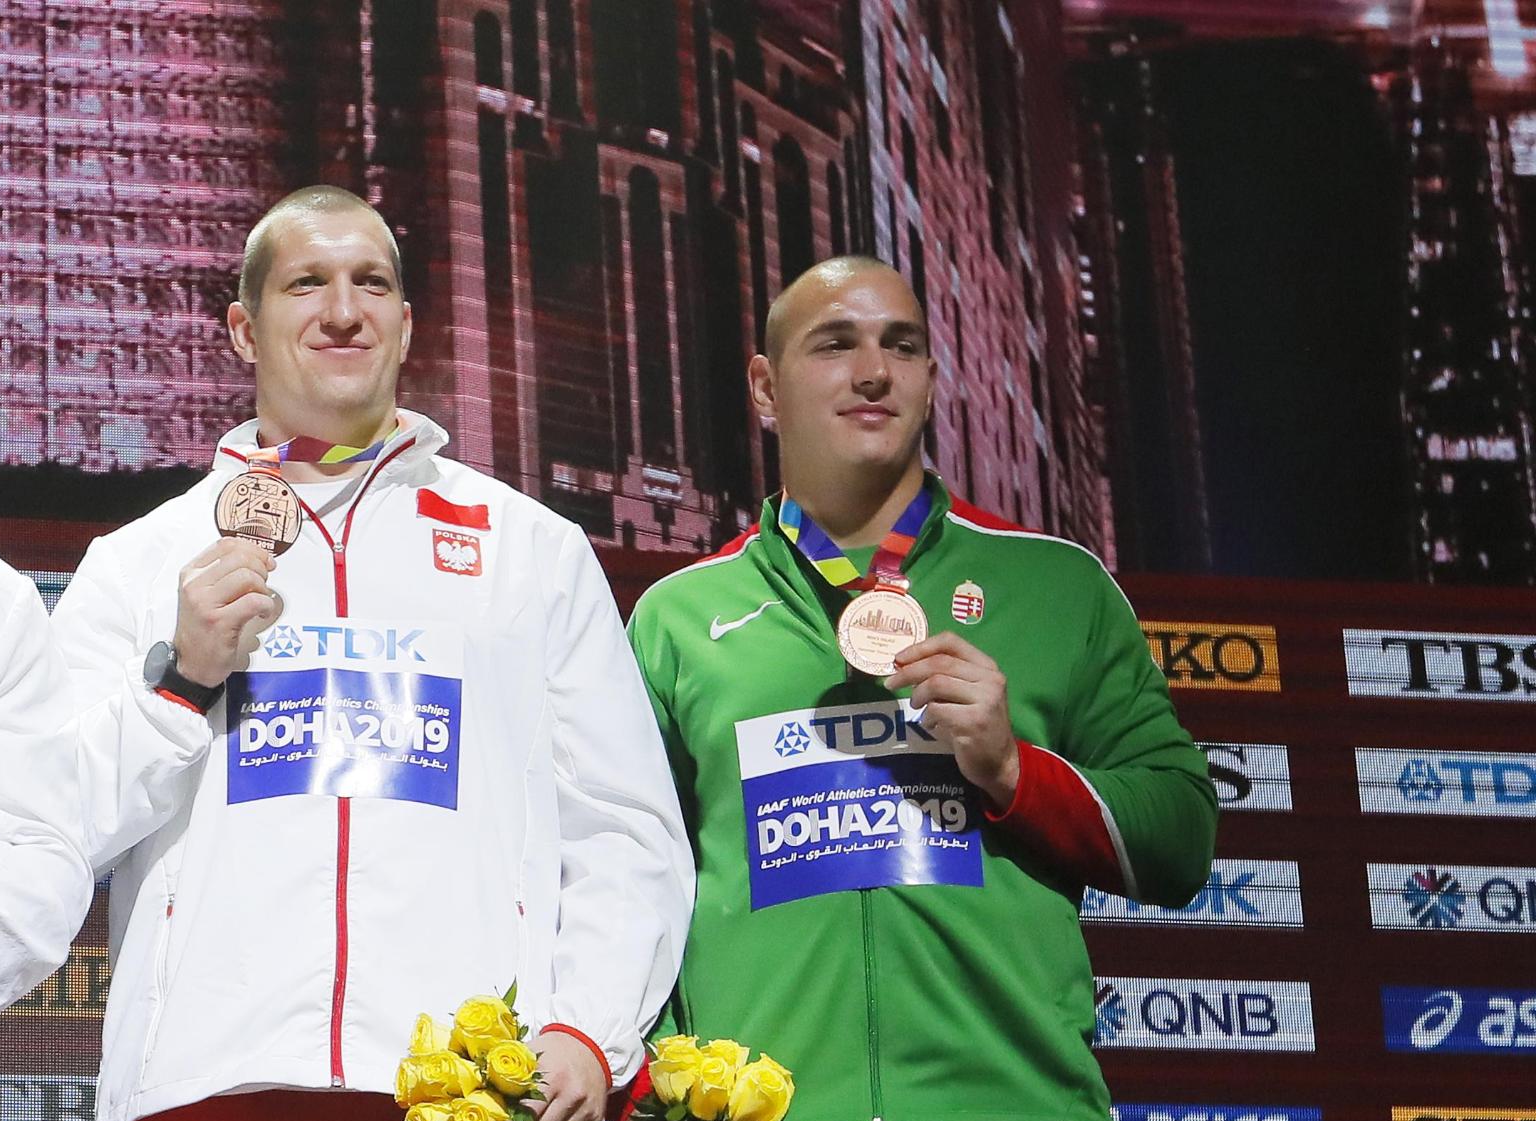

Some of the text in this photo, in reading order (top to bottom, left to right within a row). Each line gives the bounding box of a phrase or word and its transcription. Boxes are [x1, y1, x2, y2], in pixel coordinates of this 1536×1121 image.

[302, 625, 427, 662] TDK
[1381, 638, 1536, 694] TB
[241, 702, 276, 714] IAAF
[278, 697, 312, 712] World
[810, 706, 936, 750] TDK
[757, 783, 964, 816] IAAF World Athletics Championships
[757, 798, 967, 856] DOHA2019
[1141, 989, 1279, 1038] QNB
